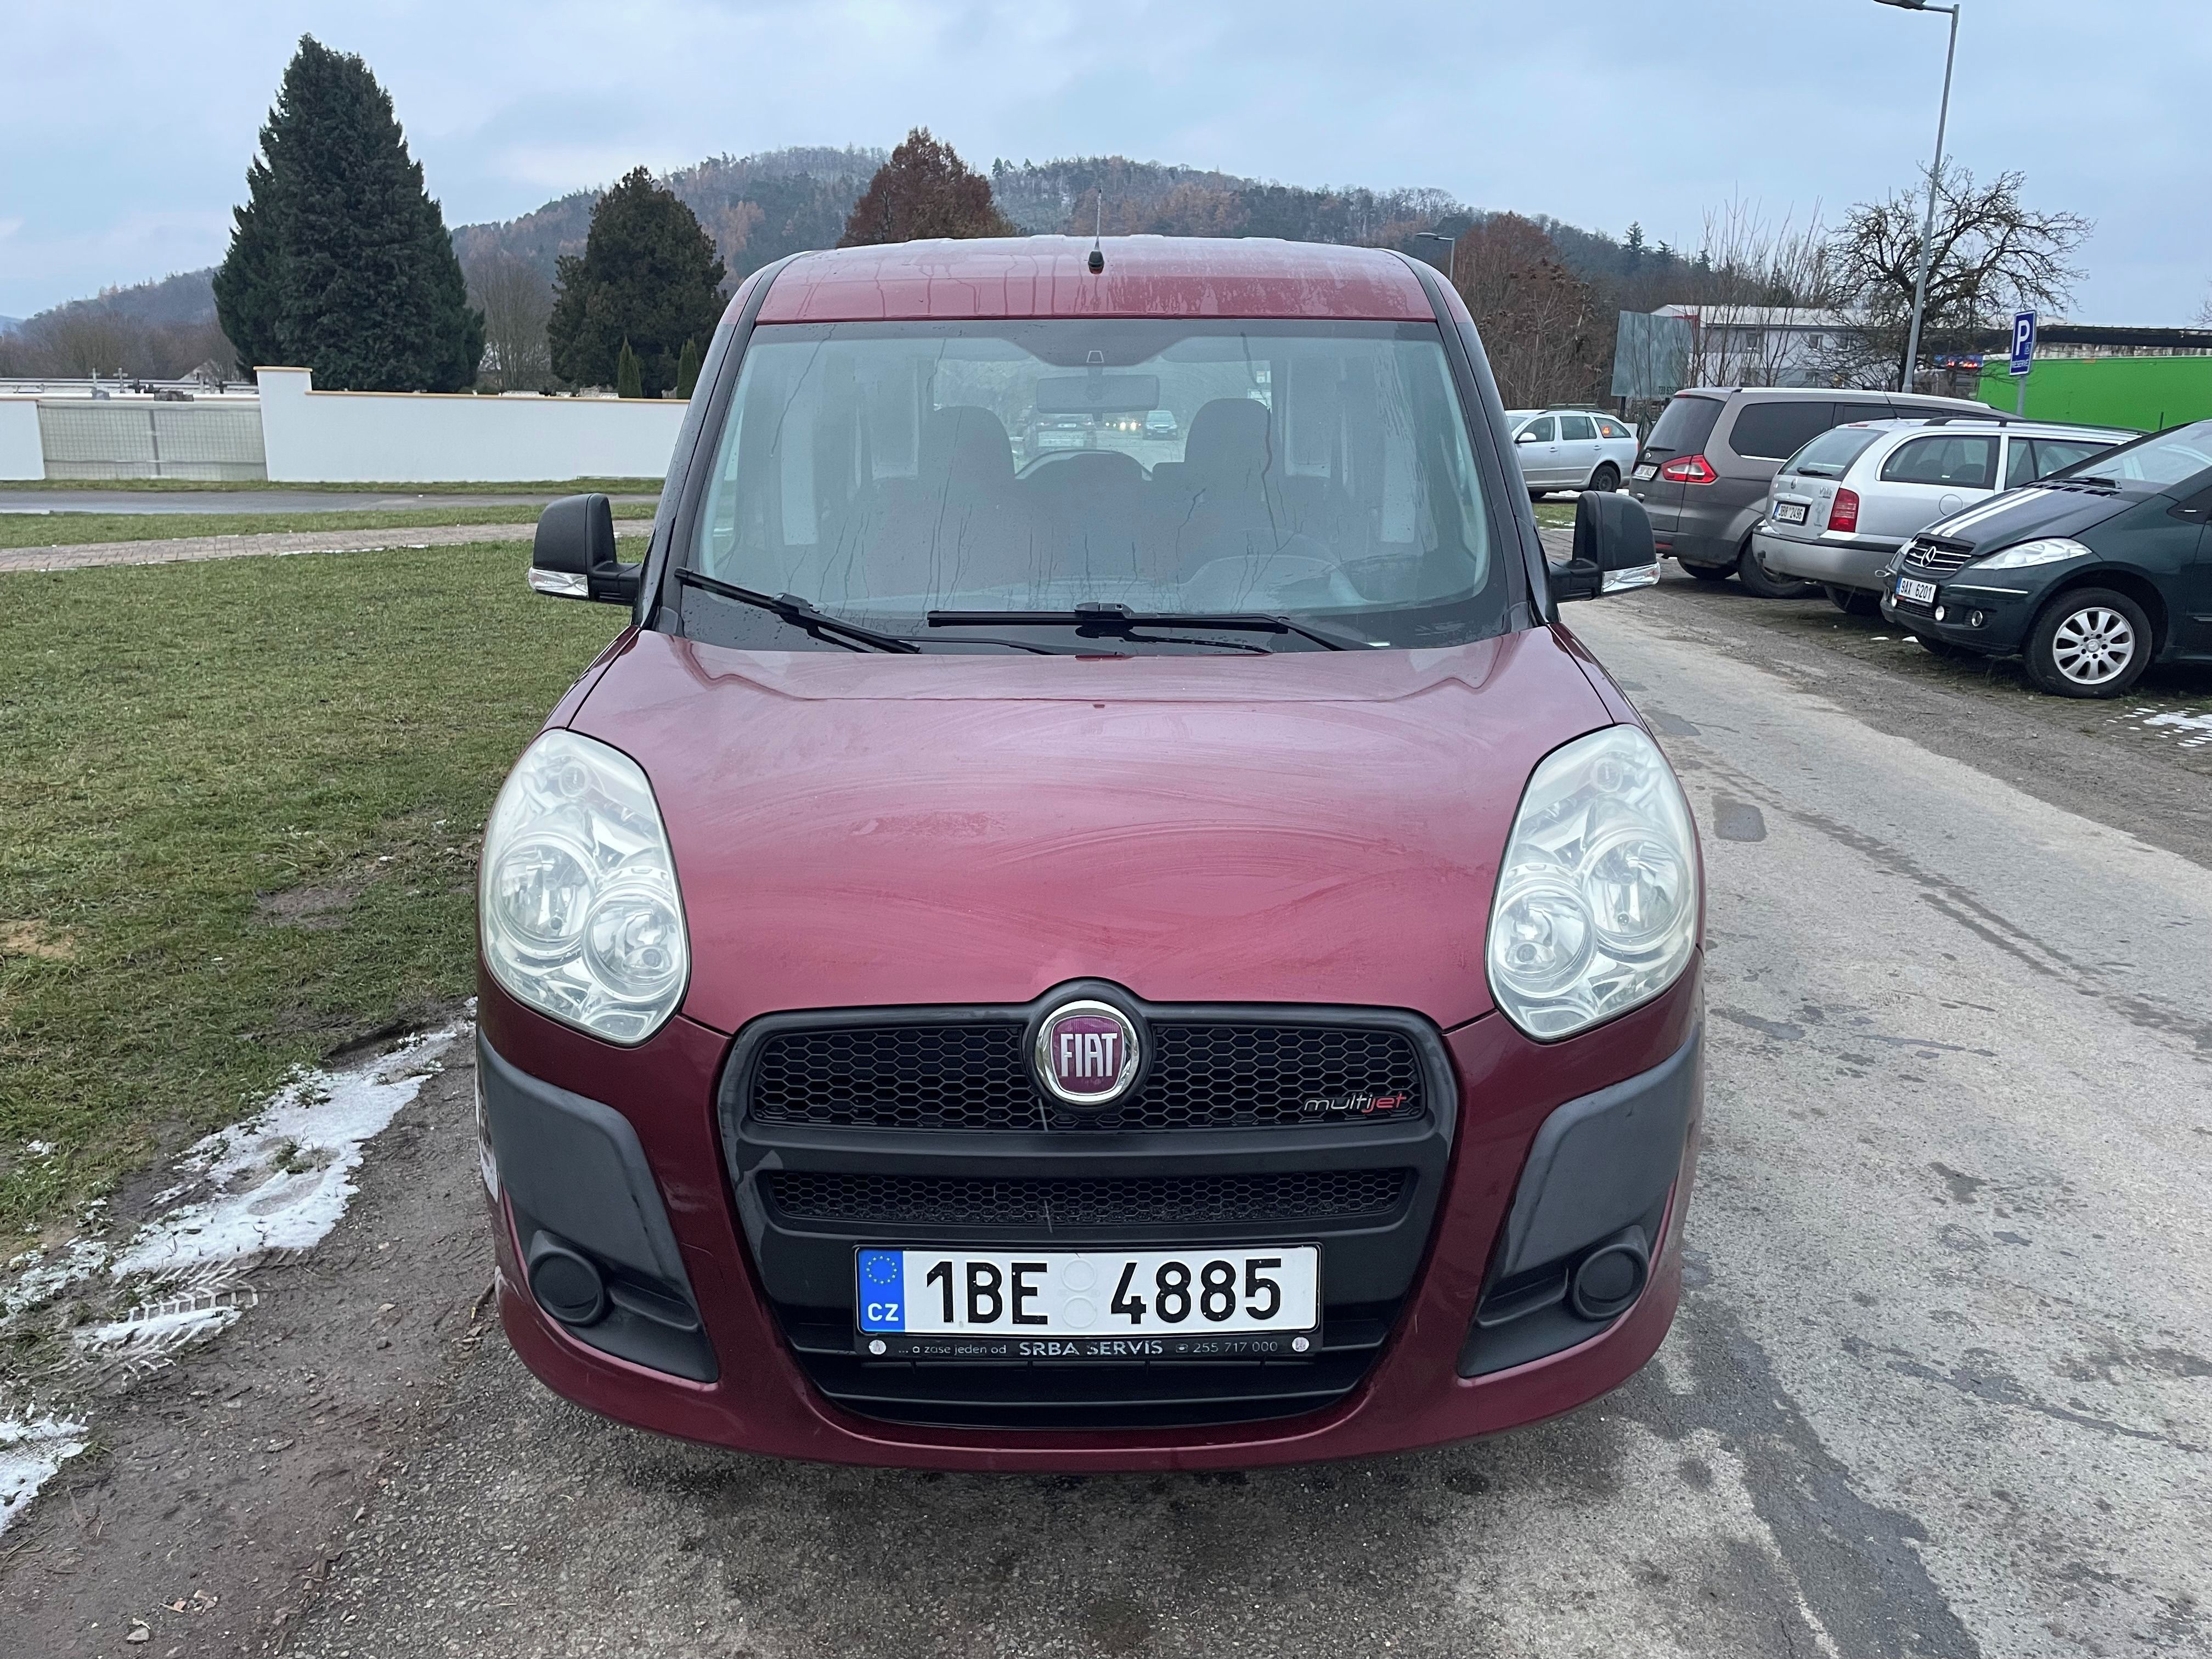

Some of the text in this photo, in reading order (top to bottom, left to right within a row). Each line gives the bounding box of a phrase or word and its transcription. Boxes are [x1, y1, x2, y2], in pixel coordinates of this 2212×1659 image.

[2016, 320, 2030, 356] P
[1901, 580, 1932, 600] 9AX 6201
[1060, 1032, 1118, 1077] FIAT
[1304, 1092, 1407, 1113] multijet
[927, 1258, 1282, 1325] 1BE 4885
[867, 1303, 899, 1322] CZ
[954, 1344, 987, 1356] jeden
[991, 1345, 1006, 1353] od
[1019, 1342, 1080, 1356] SRBA
[1193, 1342, 1218, 1353] 255
[1224, 1342, 1247, 1352] 717
[1252, 1341, 1278, 1352] 000
